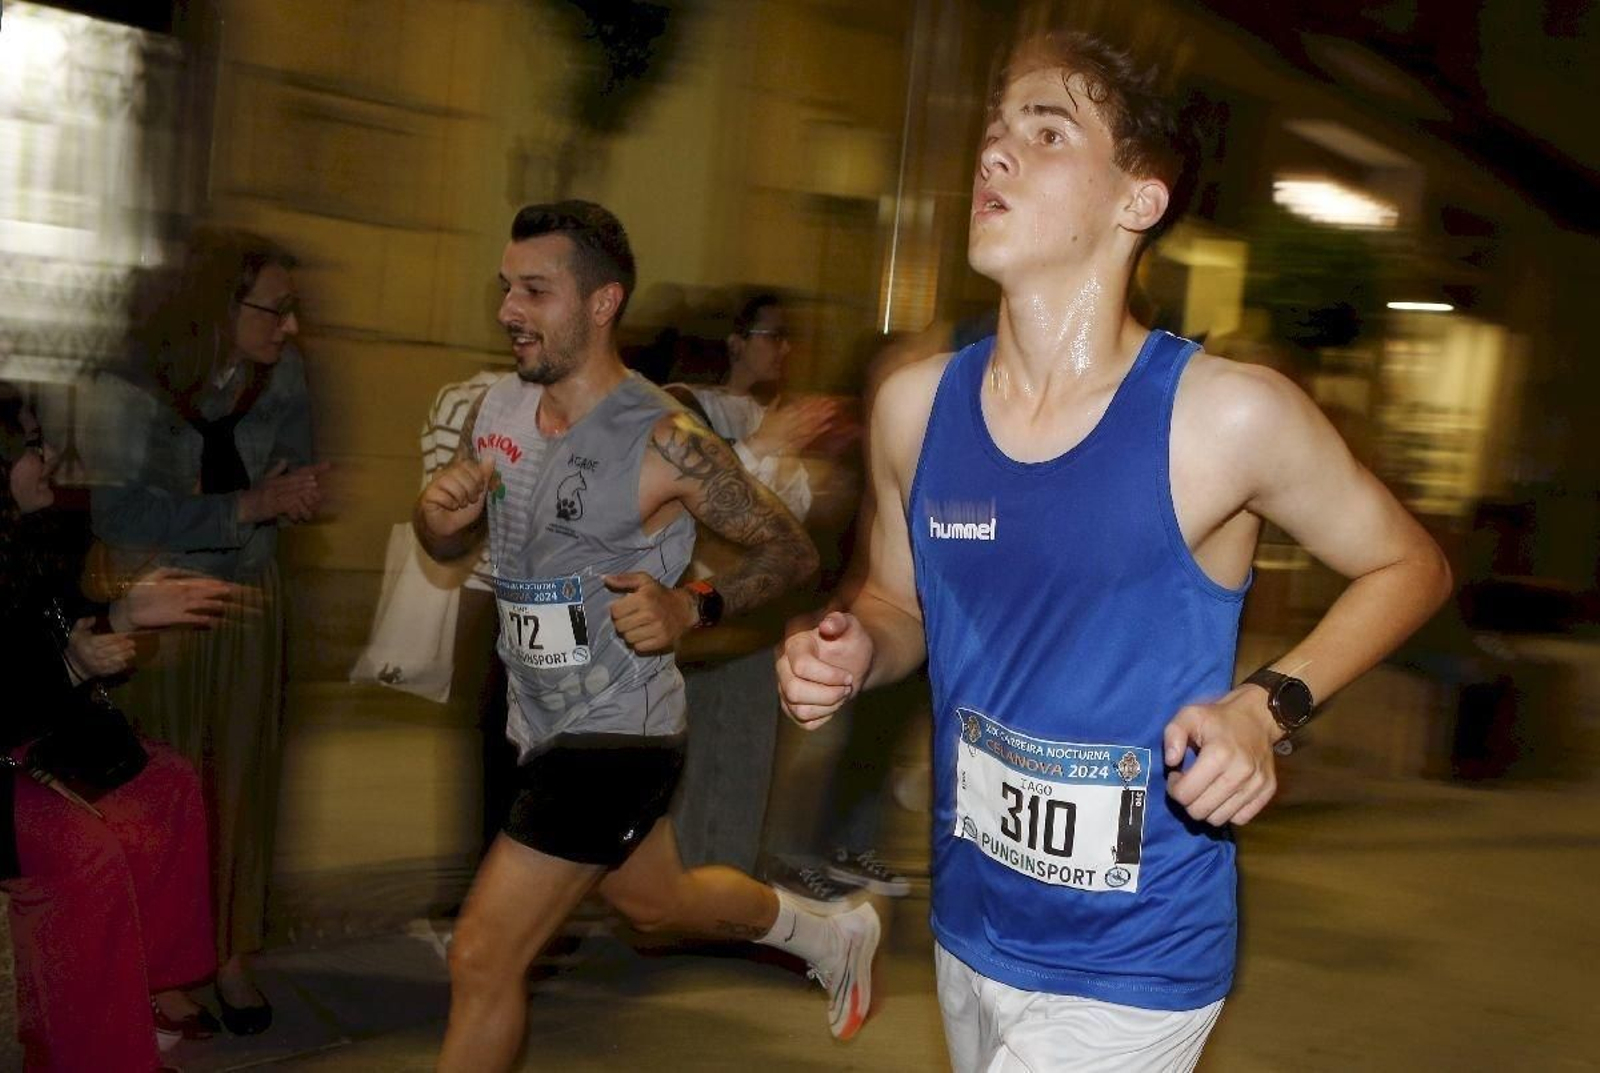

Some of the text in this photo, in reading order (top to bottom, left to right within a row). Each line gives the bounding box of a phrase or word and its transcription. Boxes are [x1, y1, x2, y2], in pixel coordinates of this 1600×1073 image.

[477, 433, 523, 463] ARION
[929, 516, 997, 540] hummel
[534, 591, 558, 602] 2024
[508, 611, 545, 650] 72
[986, 739, 1109, 779] CELANOVA 2024
[1000, 731, 1044, 757] CARREIRA
[1046, 747, 1111, 762] NOCTURNA
[1020, 778, 1053, 796] IAGO
[1000, 781, 1077, 858] 310
[981, 832, 1097, 886] PUNGINSPORT
